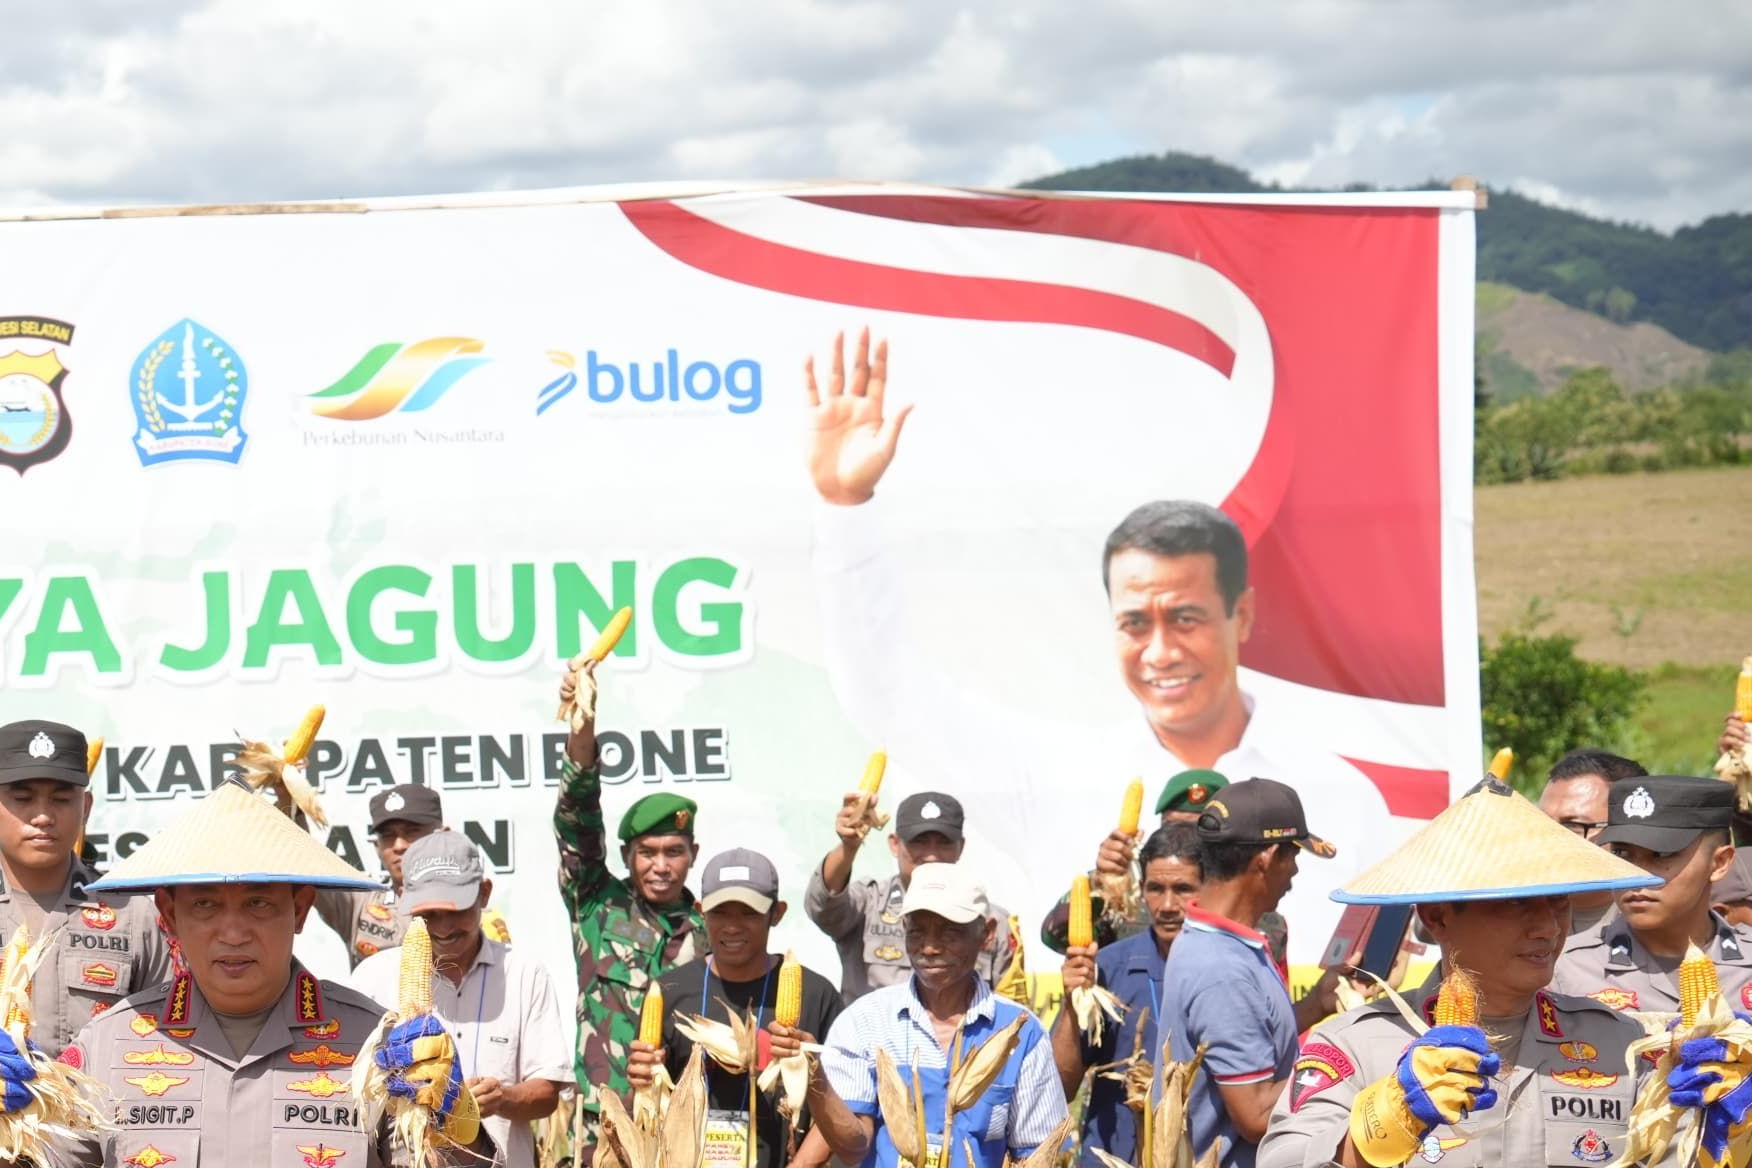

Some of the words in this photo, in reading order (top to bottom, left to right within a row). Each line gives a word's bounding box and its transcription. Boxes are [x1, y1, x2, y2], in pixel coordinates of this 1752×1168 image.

[21, 321, 70, 341] SELATAN
[587, 349, 762, 414] bulog
[303, 429, 407, 446] Perkebunan
[415, 428, 505, 443] Nusantara
[160, 557, 744, 672] JAGUNG
[106, 734, 524, 794] KABPATEN
[69, 932, 129, 951] POLRI
[284, 1104, 358, 1127] POLRI
[1551, 1096, 1621, 1121] POLRI
